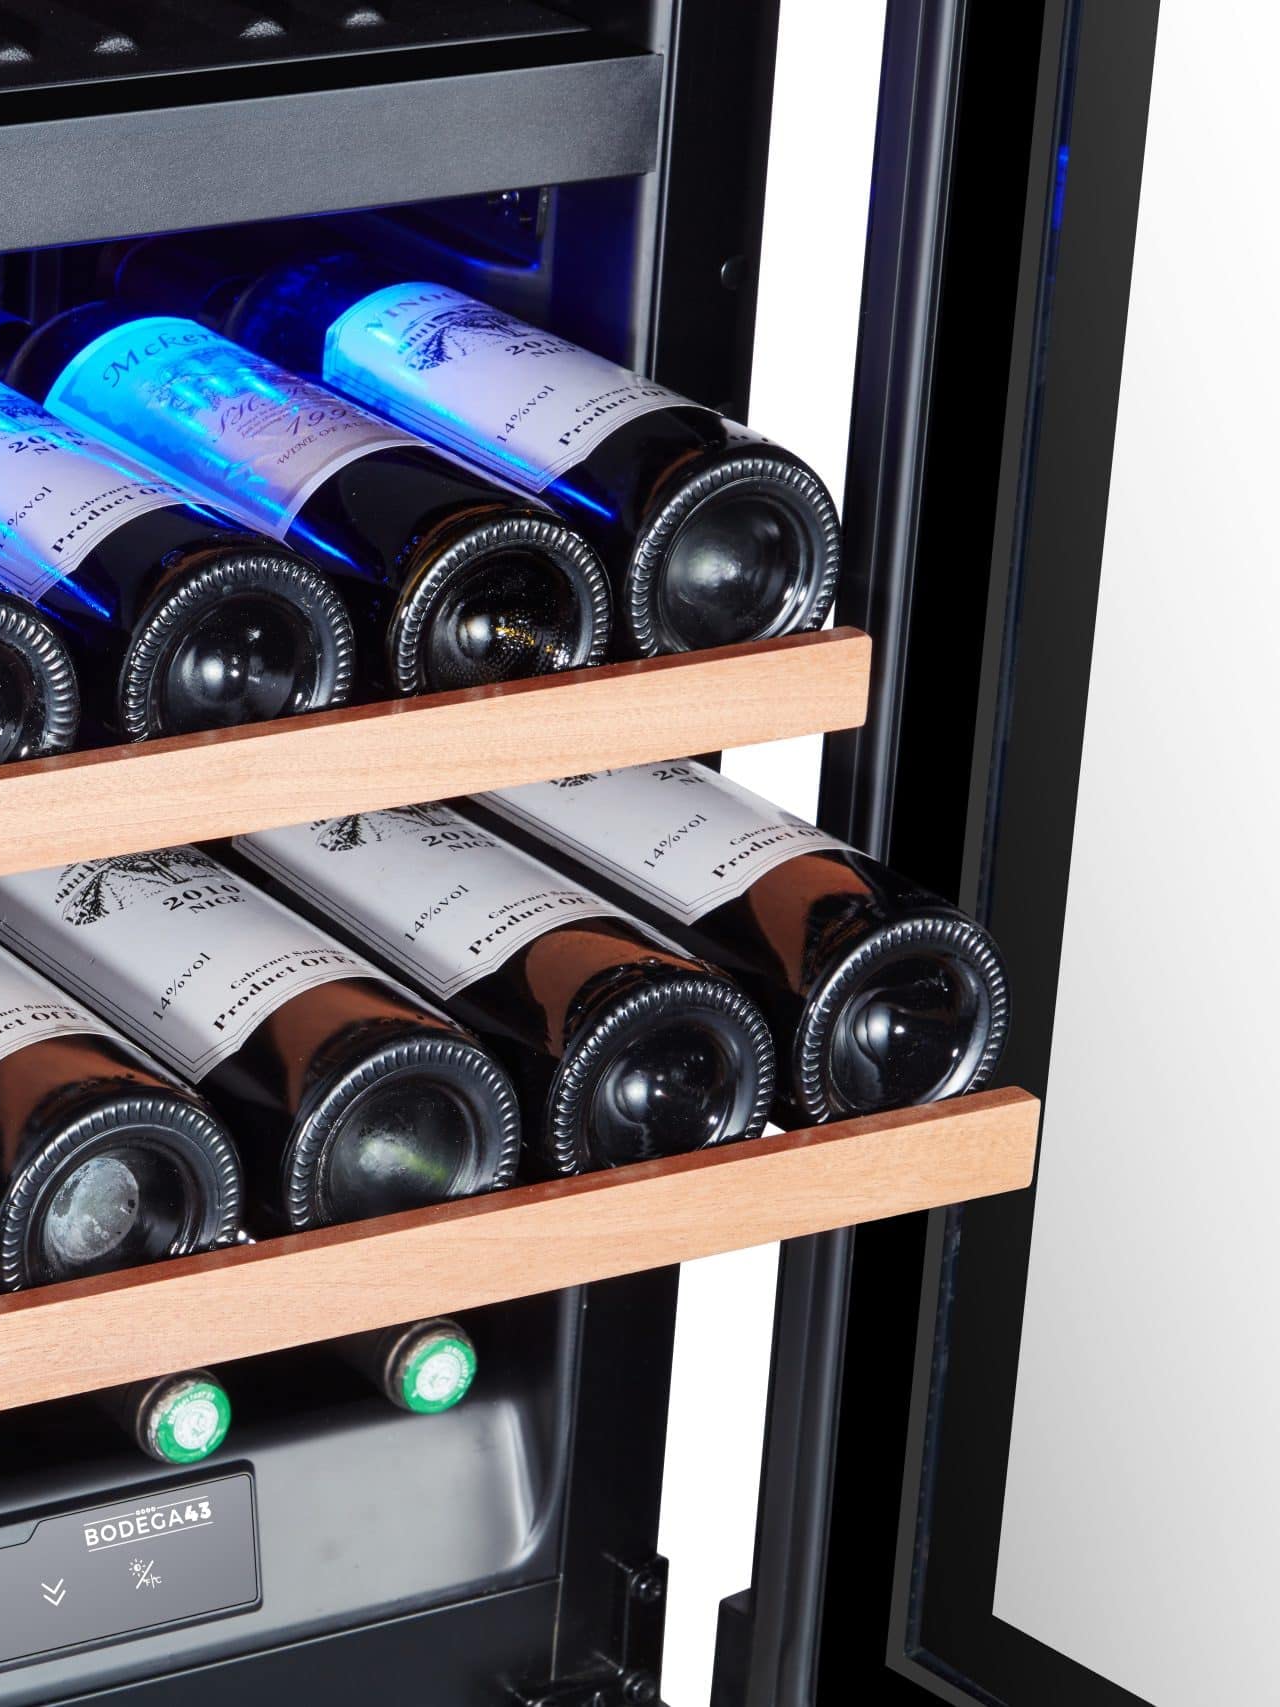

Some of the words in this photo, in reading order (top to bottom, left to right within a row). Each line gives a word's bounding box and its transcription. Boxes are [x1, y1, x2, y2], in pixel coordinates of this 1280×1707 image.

[496, 384, 556, 443] 14%vol
[558, 391, 638, 446] Product
[575, 386, 631, 413] Cabernet
[285, 407, 365, 436] 199
[33, 439, 88, 456] NIE
[277, 434, 317, 465] WINE
[69, 485, 130, 517] Cabernet
[51, 493, 135, 553] Product
[643, 813, 708, 869] 14%vol
[711, 829, 795, 880] Product
[162, 883, 242, 911] 2010
[190, 894, 247, 914] NICE
[404, 884, 471, 943] 14%vol
[488, 892, 549, 920] Cabernet
[468, 899, 555, 956] Product
[152, 951, 212, 1021] 14%vol
[230, 955, 291, 990] Cabernet
[213, 966, 299, 1032] Product
[300, 956, 330, 967] Of
[30, 1010, 61, 1022] Of
[84, 1502, 211, 1546] BODEGA43
